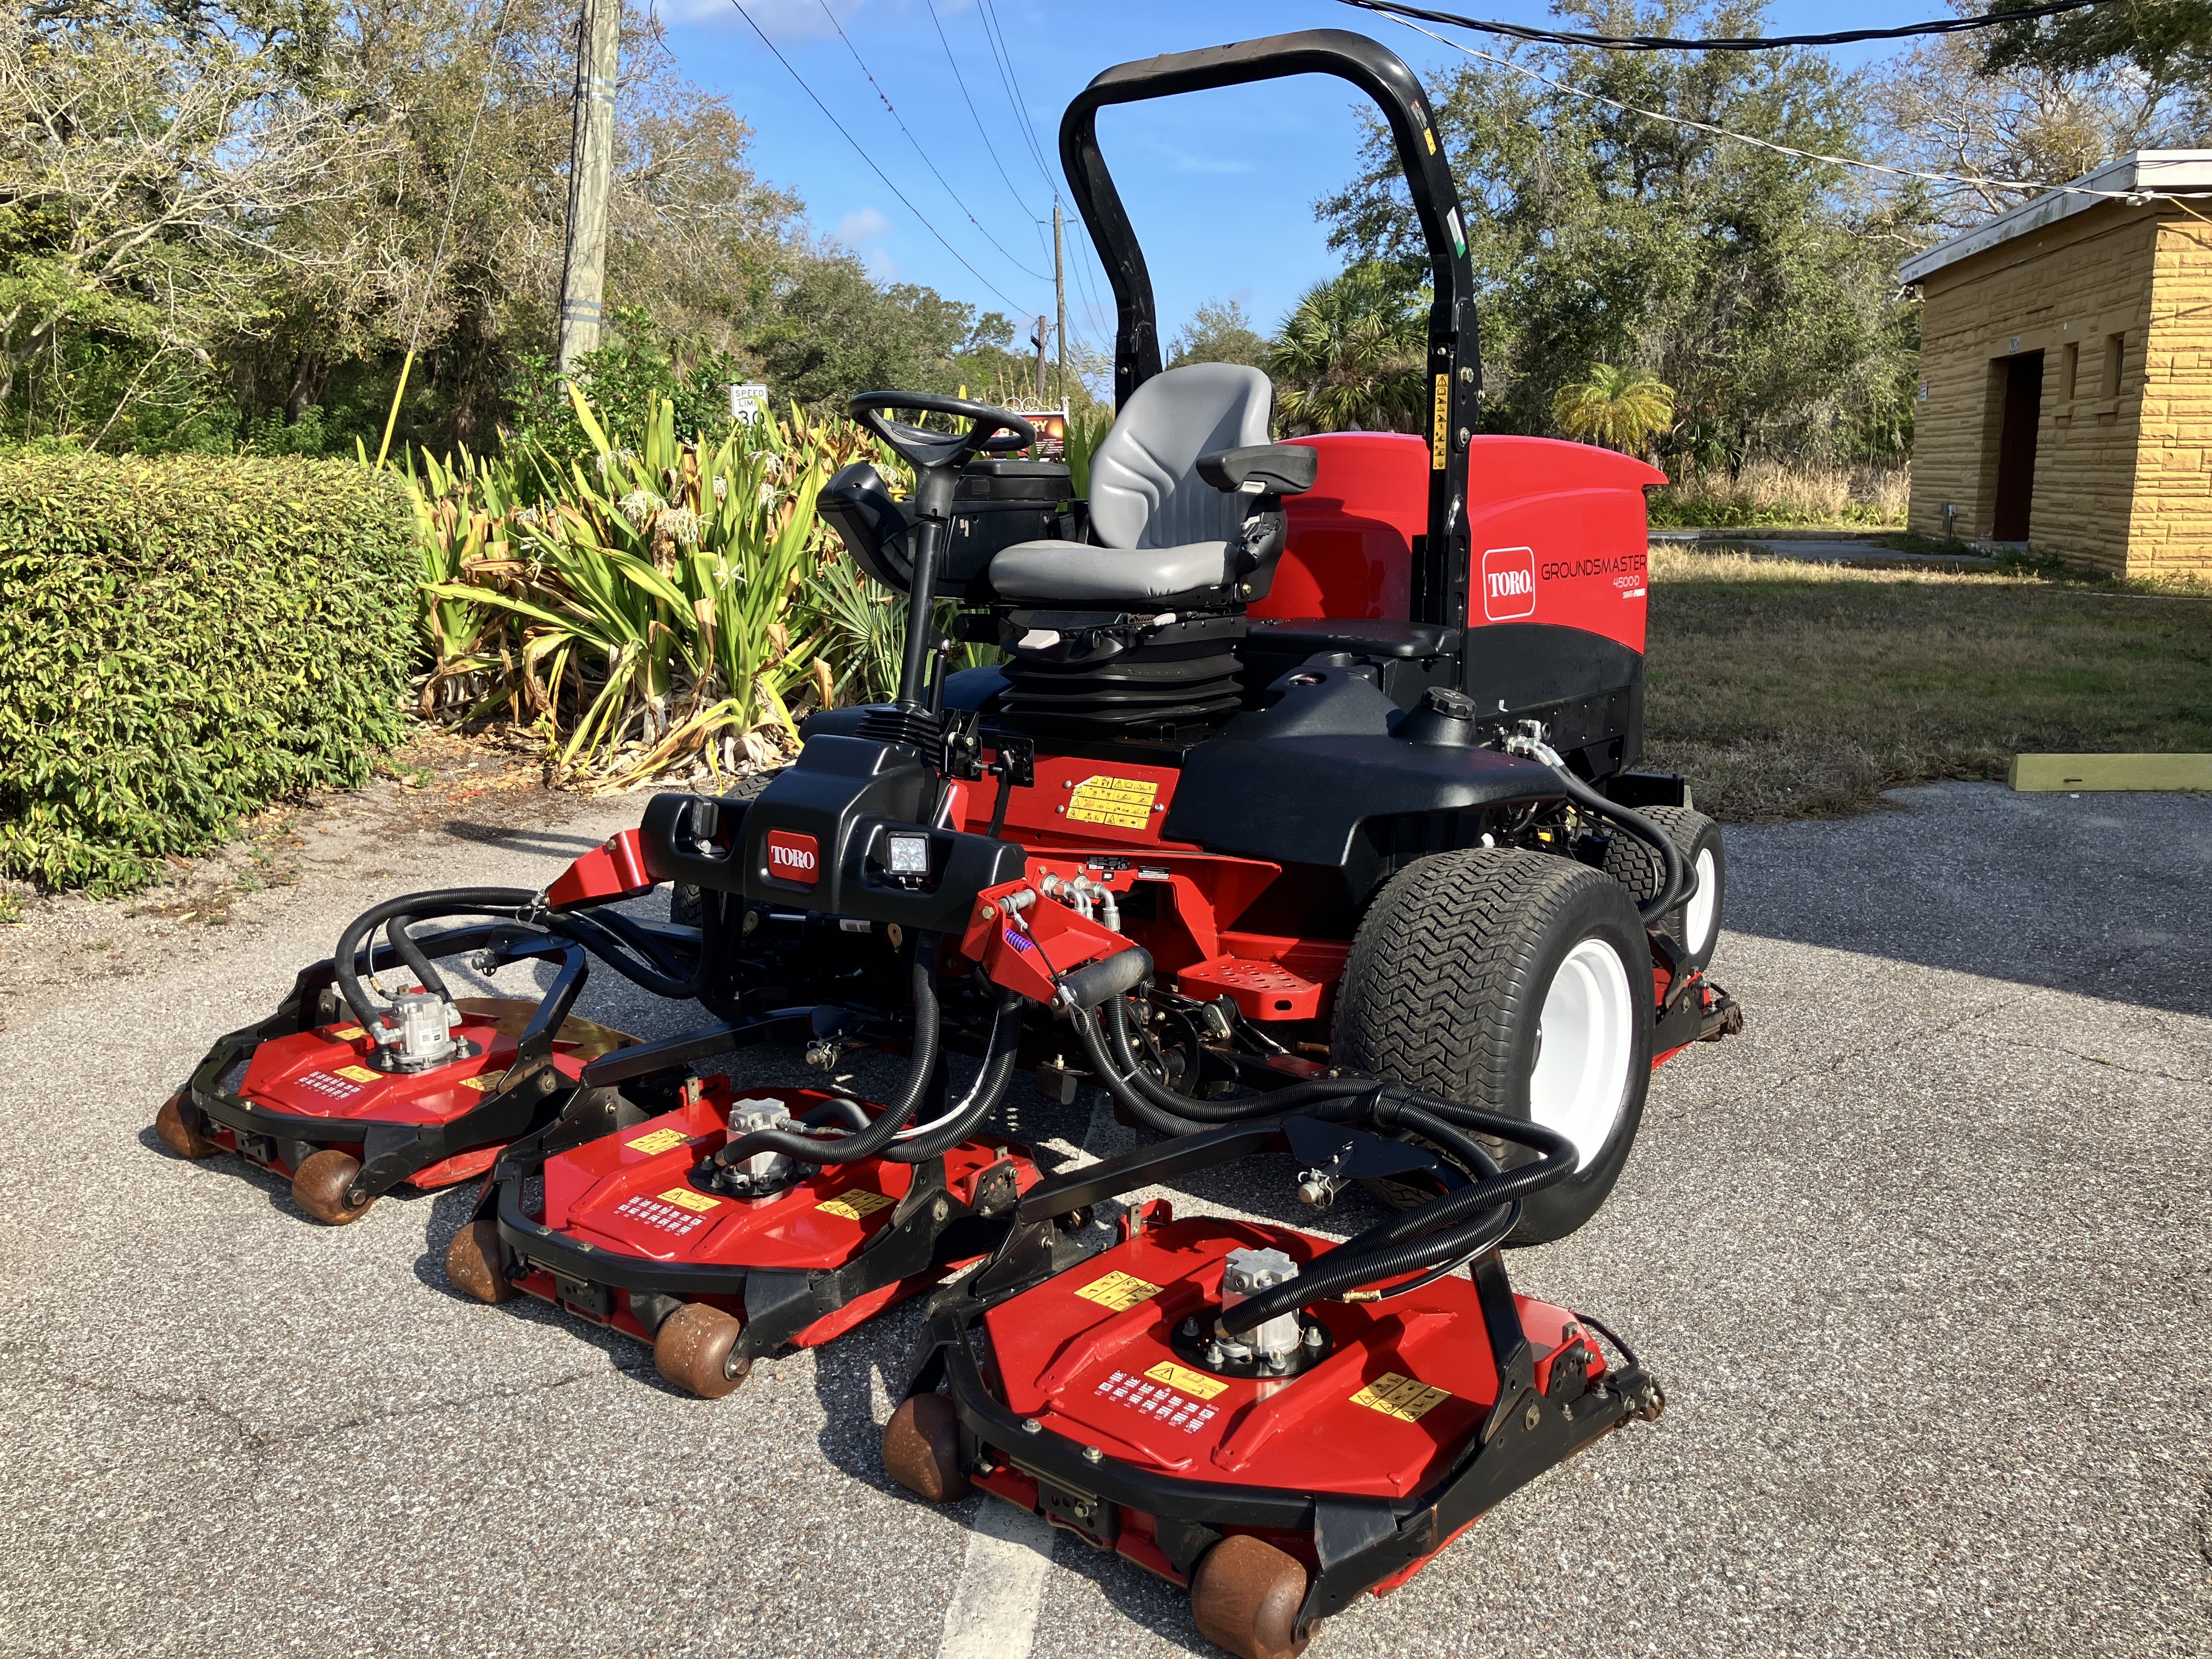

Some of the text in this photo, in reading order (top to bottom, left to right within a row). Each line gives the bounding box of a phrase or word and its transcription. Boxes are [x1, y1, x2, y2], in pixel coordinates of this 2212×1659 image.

[738, 410, 765, 425] 30
[1541, 554, 1646, 580] GROUNDSMASTER
[1487, 569, 1531, 597] TORO
[771, 845, 815, 870] TORO
